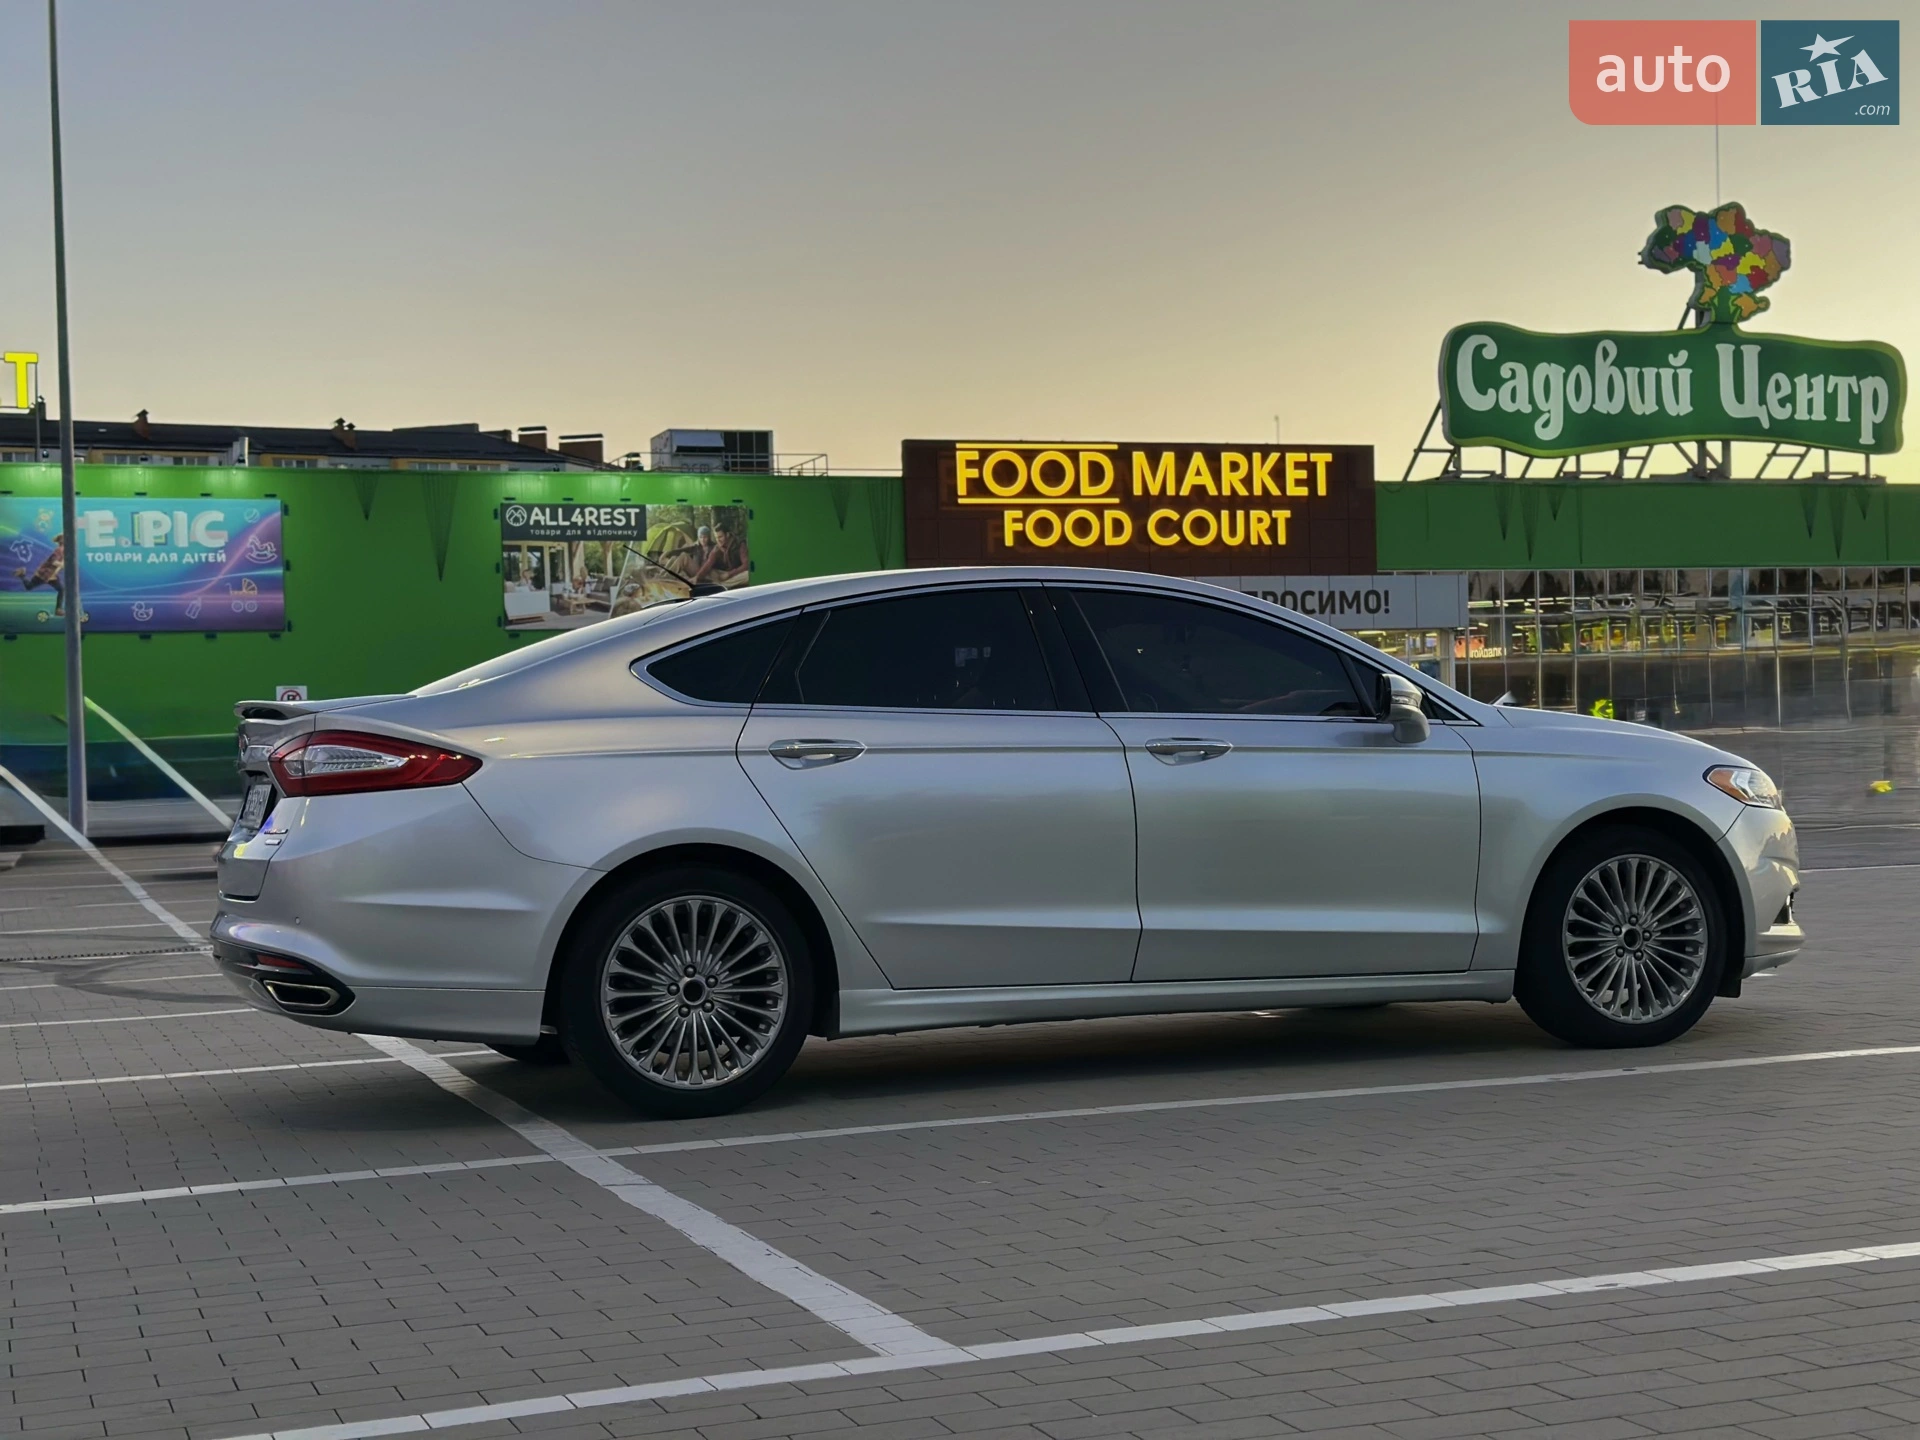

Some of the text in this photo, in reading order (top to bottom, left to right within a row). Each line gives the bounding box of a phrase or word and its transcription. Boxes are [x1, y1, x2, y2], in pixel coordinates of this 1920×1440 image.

[1456, 334, 1889, 445] Садовий Центр
[956, 450, 1333, 497] FOOD MARKET
[529, 506, 640, 527] ALL4REST
[1003, 509, 1292, 547] FOOD COURT
[530, 529, 561, 537] товари
[586, 528, 638, 537] відпочинку
[86, 549, 227, 564] ТОВАРИ ДЛЯ ДІТЕЙ
[1241, 589, 1390, 615] РОСИМО!
